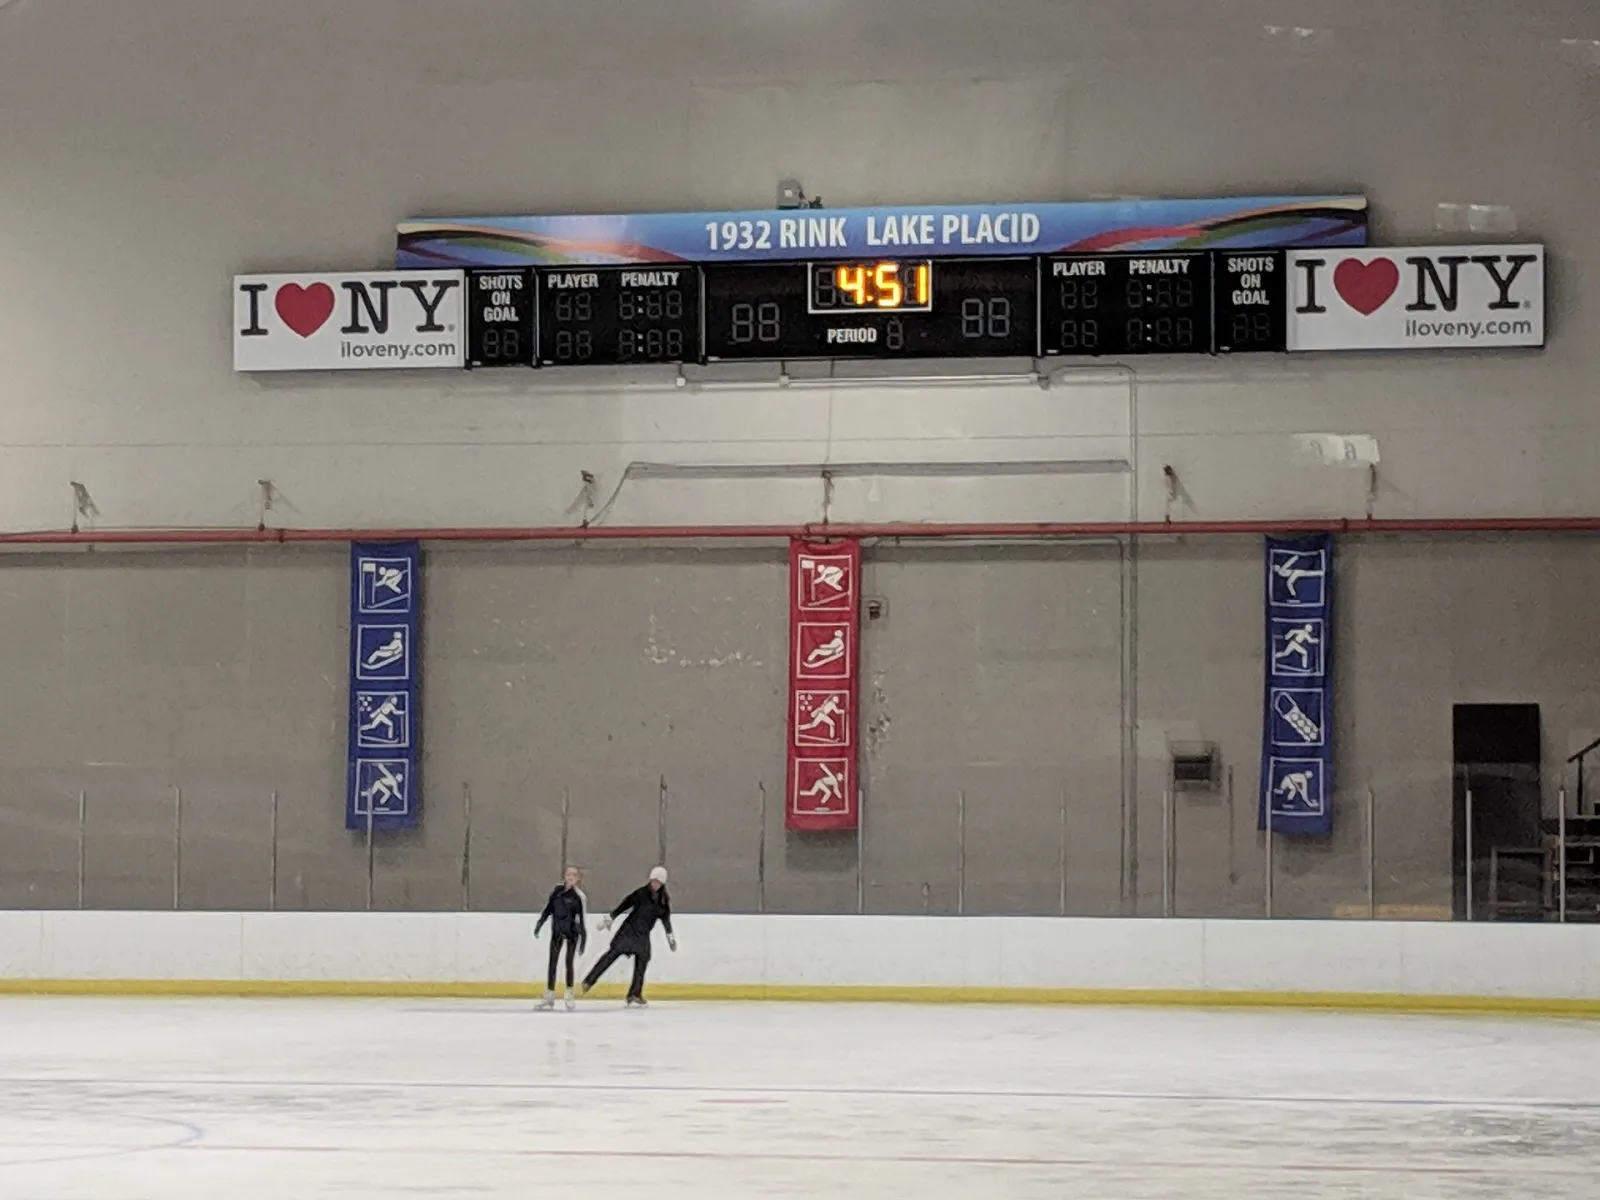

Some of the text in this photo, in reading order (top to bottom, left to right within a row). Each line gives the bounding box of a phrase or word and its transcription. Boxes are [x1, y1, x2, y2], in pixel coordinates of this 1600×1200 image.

[706, 213, 1040, 250] 1932 RINK LAKE PLACID
[1053, 261, 1106, 276] PLAYER
[1129, 259, 1191, 275] PENALTY
[1227, 257, 1274, 273] SHOTS
[479, 275, 523, 290] SHOTS
[548, 273, 599, 289] PLAYER
[621, 272, 679, 287] PENALTY
[836, 261, 928, 308] 4:51
[1241, 274, 1261, 289] ON
[1295, 255, 1537, 313] I NY
[491, 292, 511, 306] ON
[1232, 290, 1270, 305] GOAL
[240, 280, 460, 336] I NY
[483, 308, 519, 323] GOAL
[827, 328, 877, 344] PERIOD
[1405, 318, 1532, 338] iloveny.com
[340, 341, 456, 360] iloveny.com
